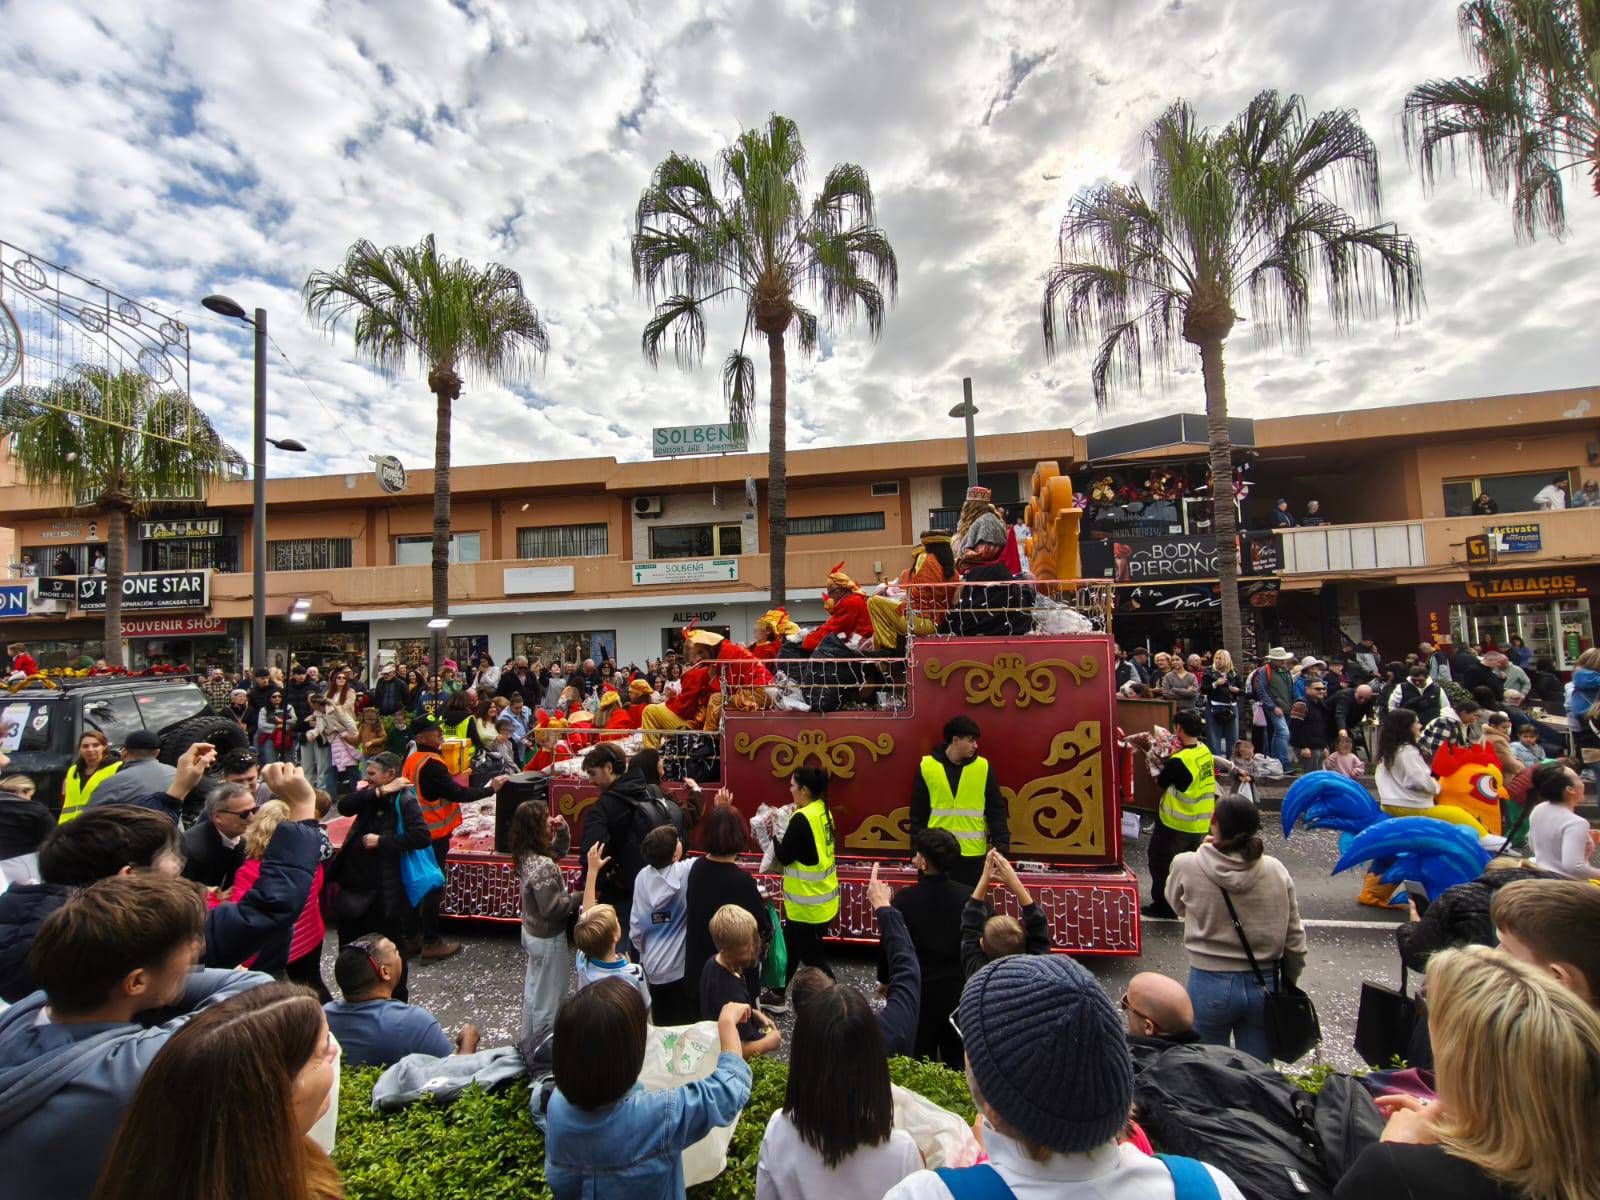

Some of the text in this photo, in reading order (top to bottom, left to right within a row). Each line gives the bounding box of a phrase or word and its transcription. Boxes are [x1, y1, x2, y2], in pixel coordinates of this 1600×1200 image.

[656, 427, 738, 446] SOLBEN
[1152, 542, 1201, 559] BODY
[100, 577, 201, 596] PONE STAR
[1490, 576, 1576, 592] TABACOS
[672, 611, 717, 623] ALE-HOP
[120, 619, 221, 633] SOUVENIR SHOP
